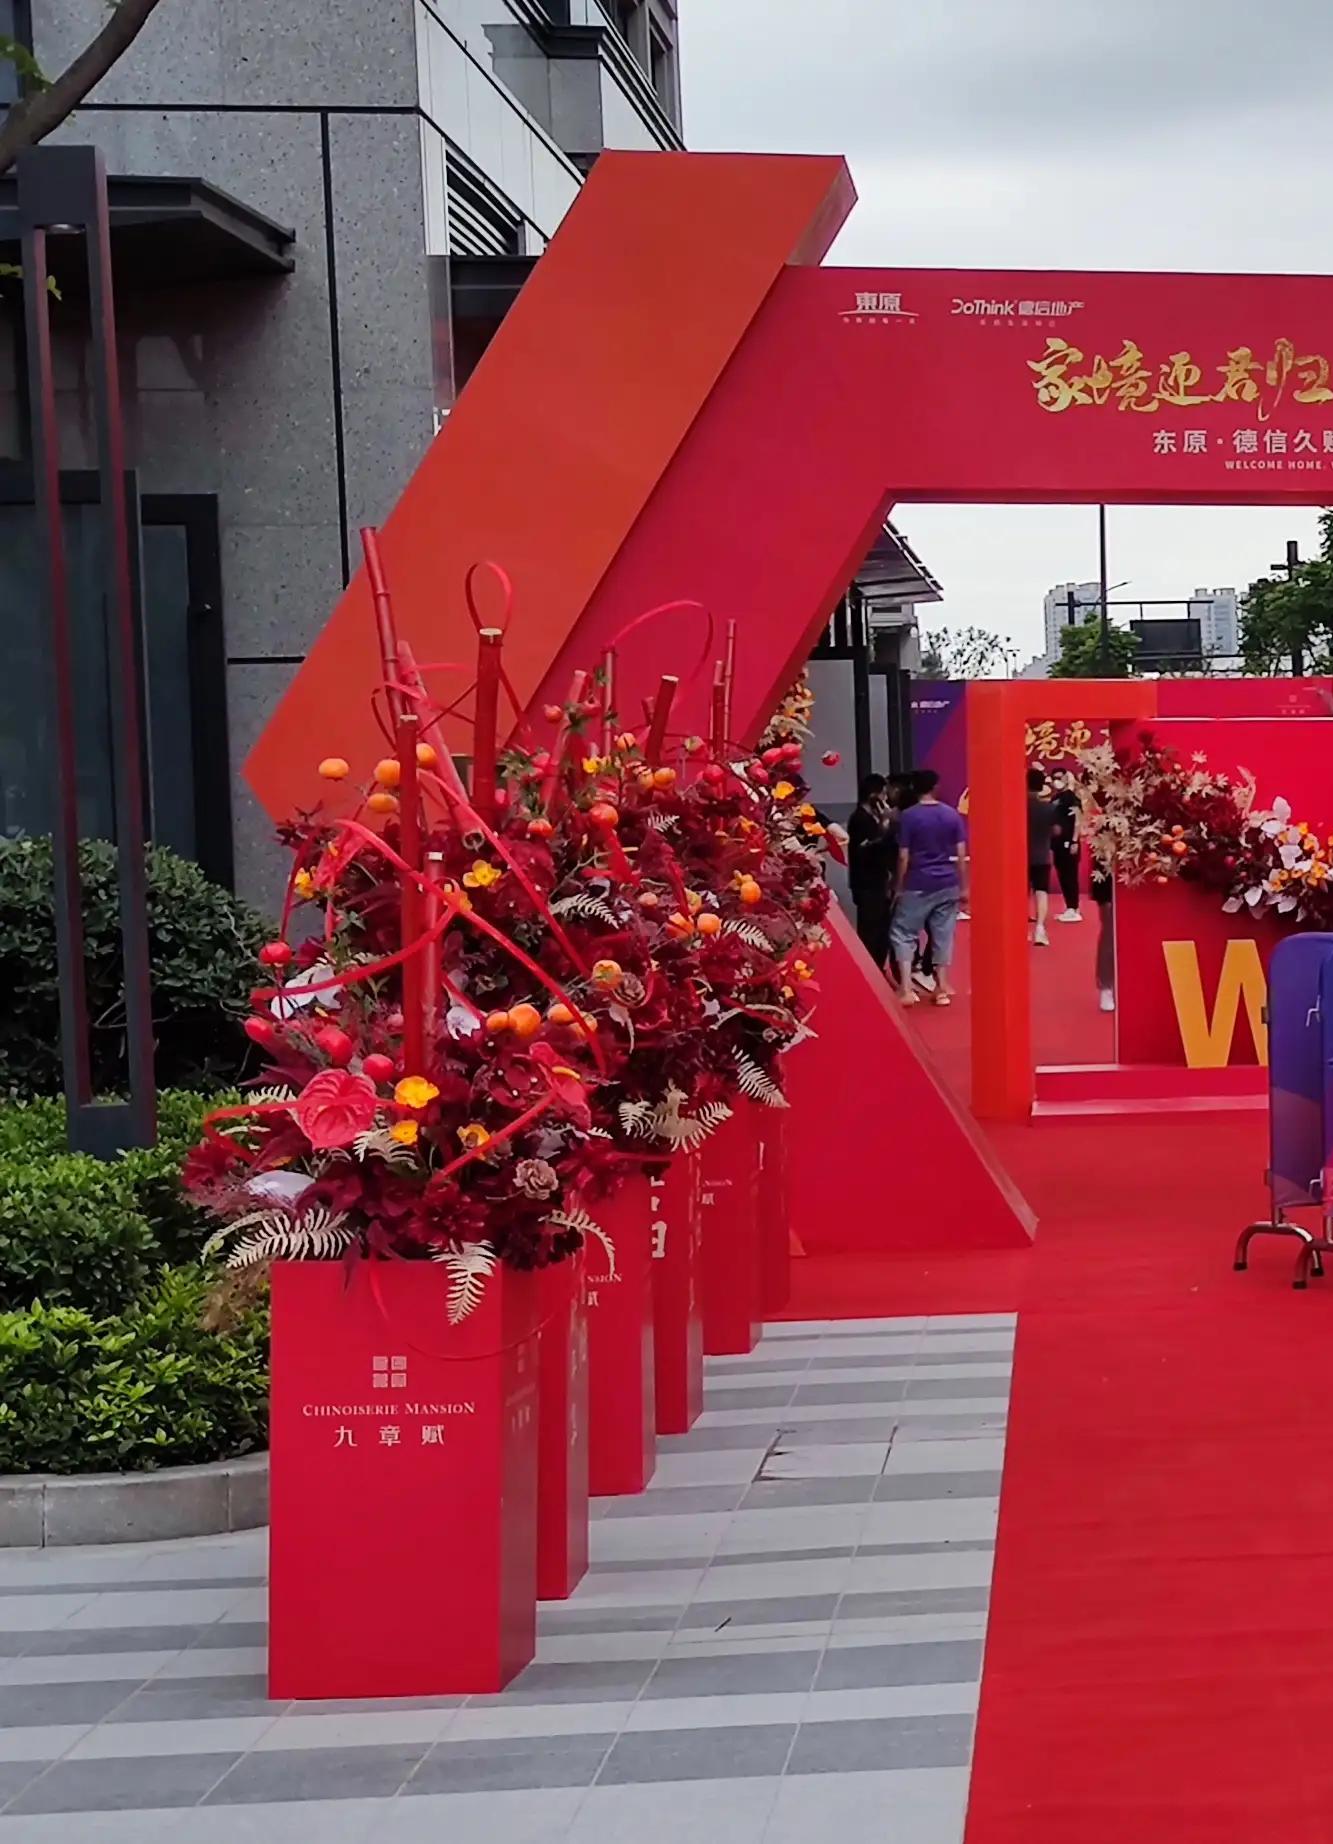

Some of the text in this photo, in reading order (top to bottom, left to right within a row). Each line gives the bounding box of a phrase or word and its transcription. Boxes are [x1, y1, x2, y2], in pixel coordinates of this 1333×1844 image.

[1225, 460, 1283, 470] WELCOME
[302, 1401, 476, 1418] CHINOISERIE MANSION
[332, 1424, 445, 1448] 九章赋
